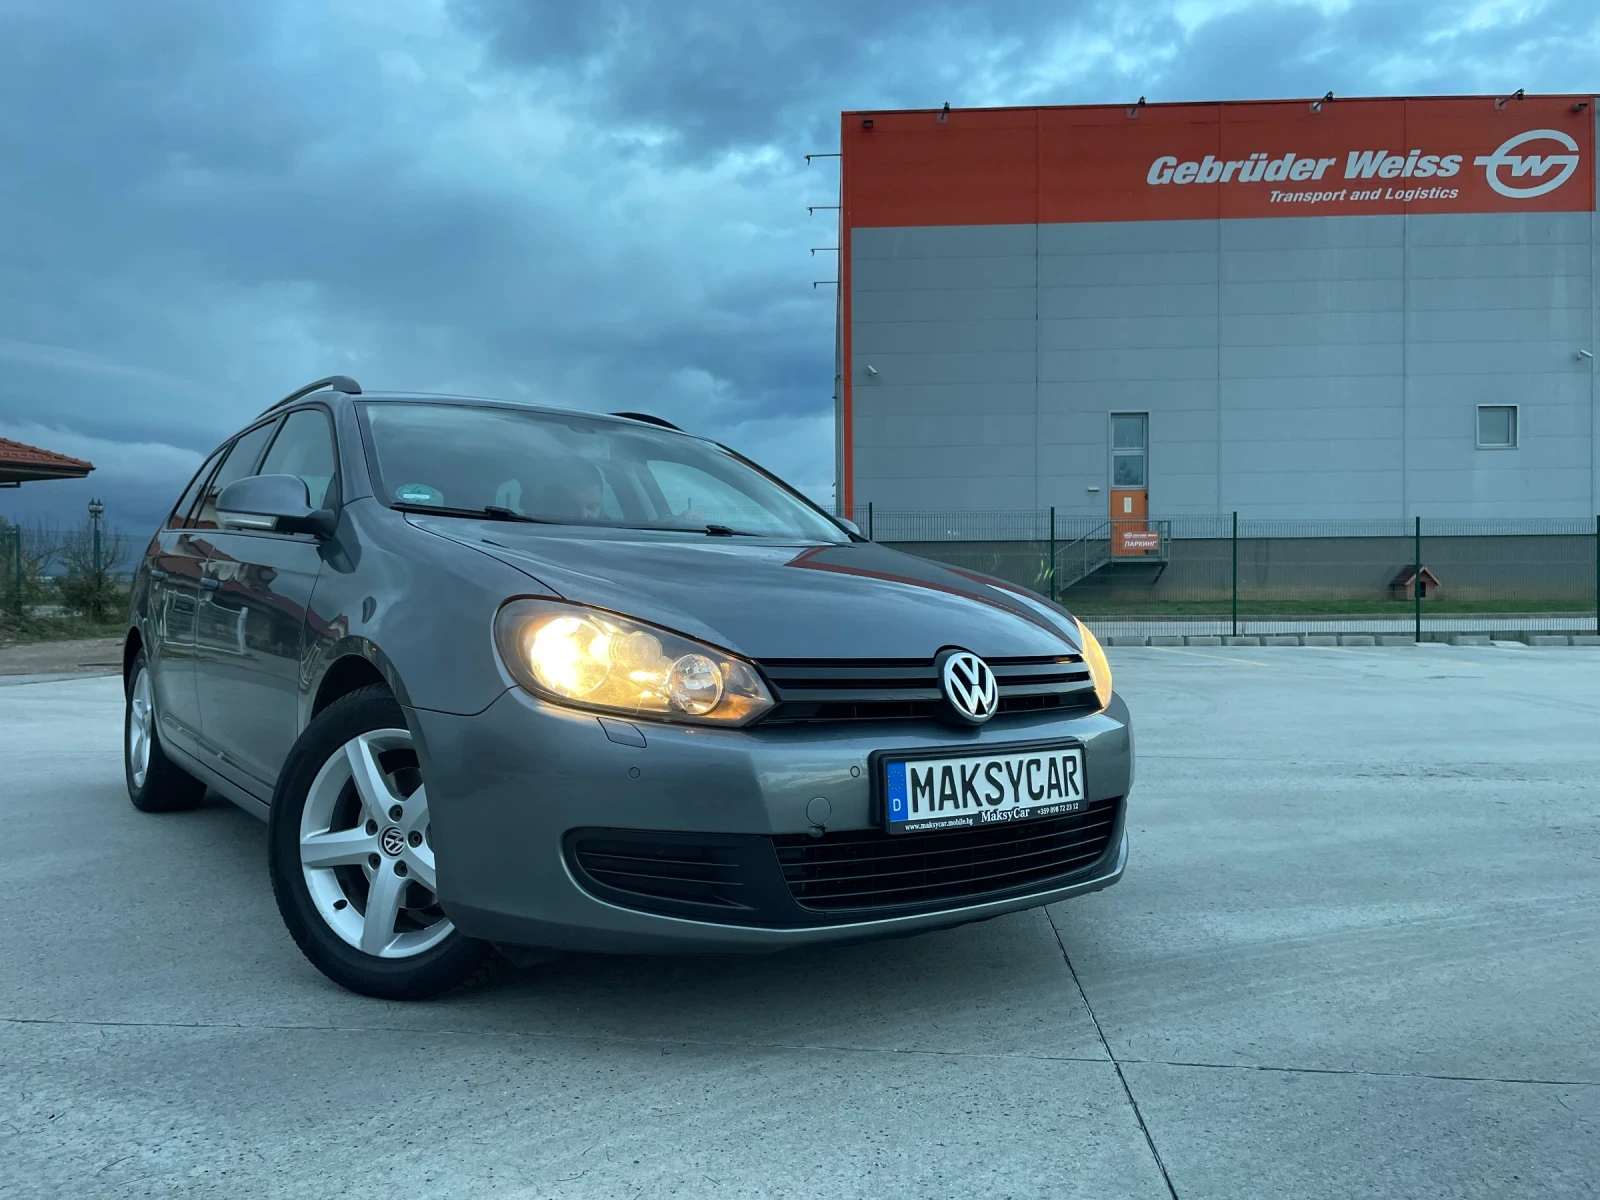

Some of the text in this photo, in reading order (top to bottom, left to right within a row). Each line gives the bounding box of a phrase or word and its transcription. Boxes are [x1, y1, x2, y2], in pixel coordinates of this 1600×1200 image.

[1146, 149, 1463, 186] Gebrüder Weiss
[1269, 186, 1459, 204] Transport and Logistics
[910, 755, 1080, 812] MAKSYCAR
[892, 798, 901, 811] D
[980, 808, 1030, 823] MaksyCar
[904, 818, 973, 830] www.maksycar.mobile.bg
